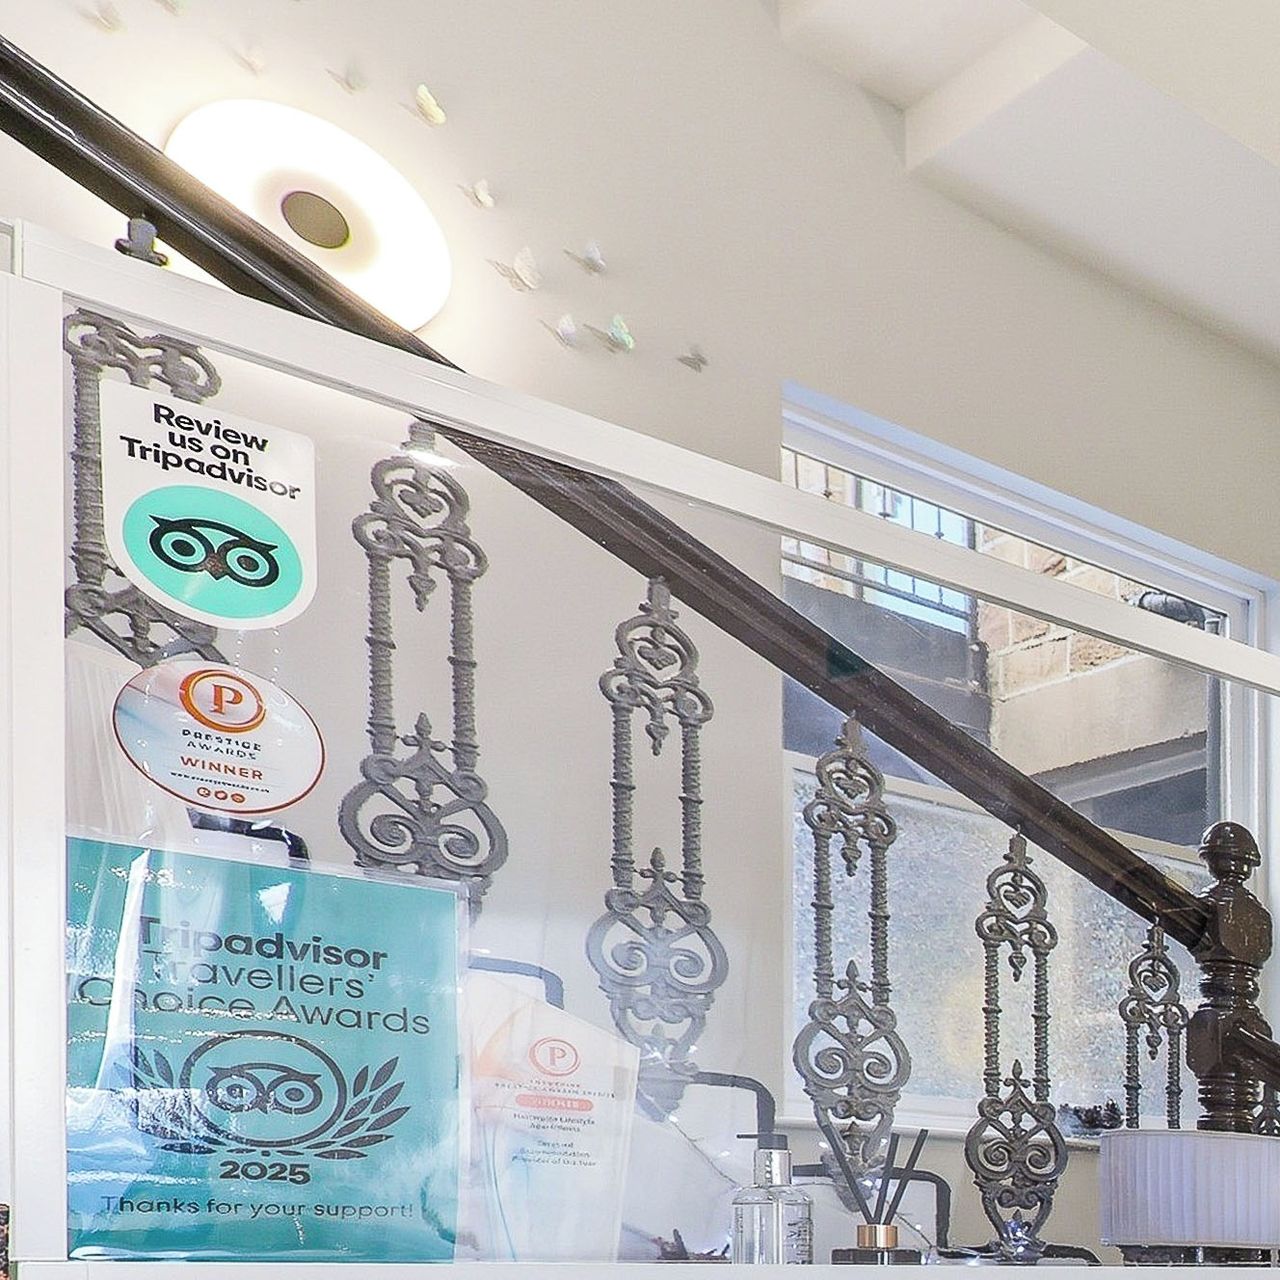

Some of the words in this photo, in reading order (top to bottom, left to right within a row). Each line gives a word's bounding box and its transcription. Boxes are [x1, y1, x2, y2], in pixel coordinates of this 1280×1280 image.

[154, 403, 268, 452] Review
[168, 431, 204, 453] us
[210, 444, 250, 466] on
[120, 435, 301, 499] Tripadvisor
[210, 684, 243, 715] P
[180, 755, 263, 781] WINNER
[139, 915, 388, 970] Tripadvisor
[273, 996, 431, 1035] Awards
[218, 1160, 311, 1185] 2025
[101, 1196, 199, 1214] Thanks
[206, 1197, 244, 1215] for
[251, 1202, 305, 1219] your
[314, 1202, 413, 1220] support!
